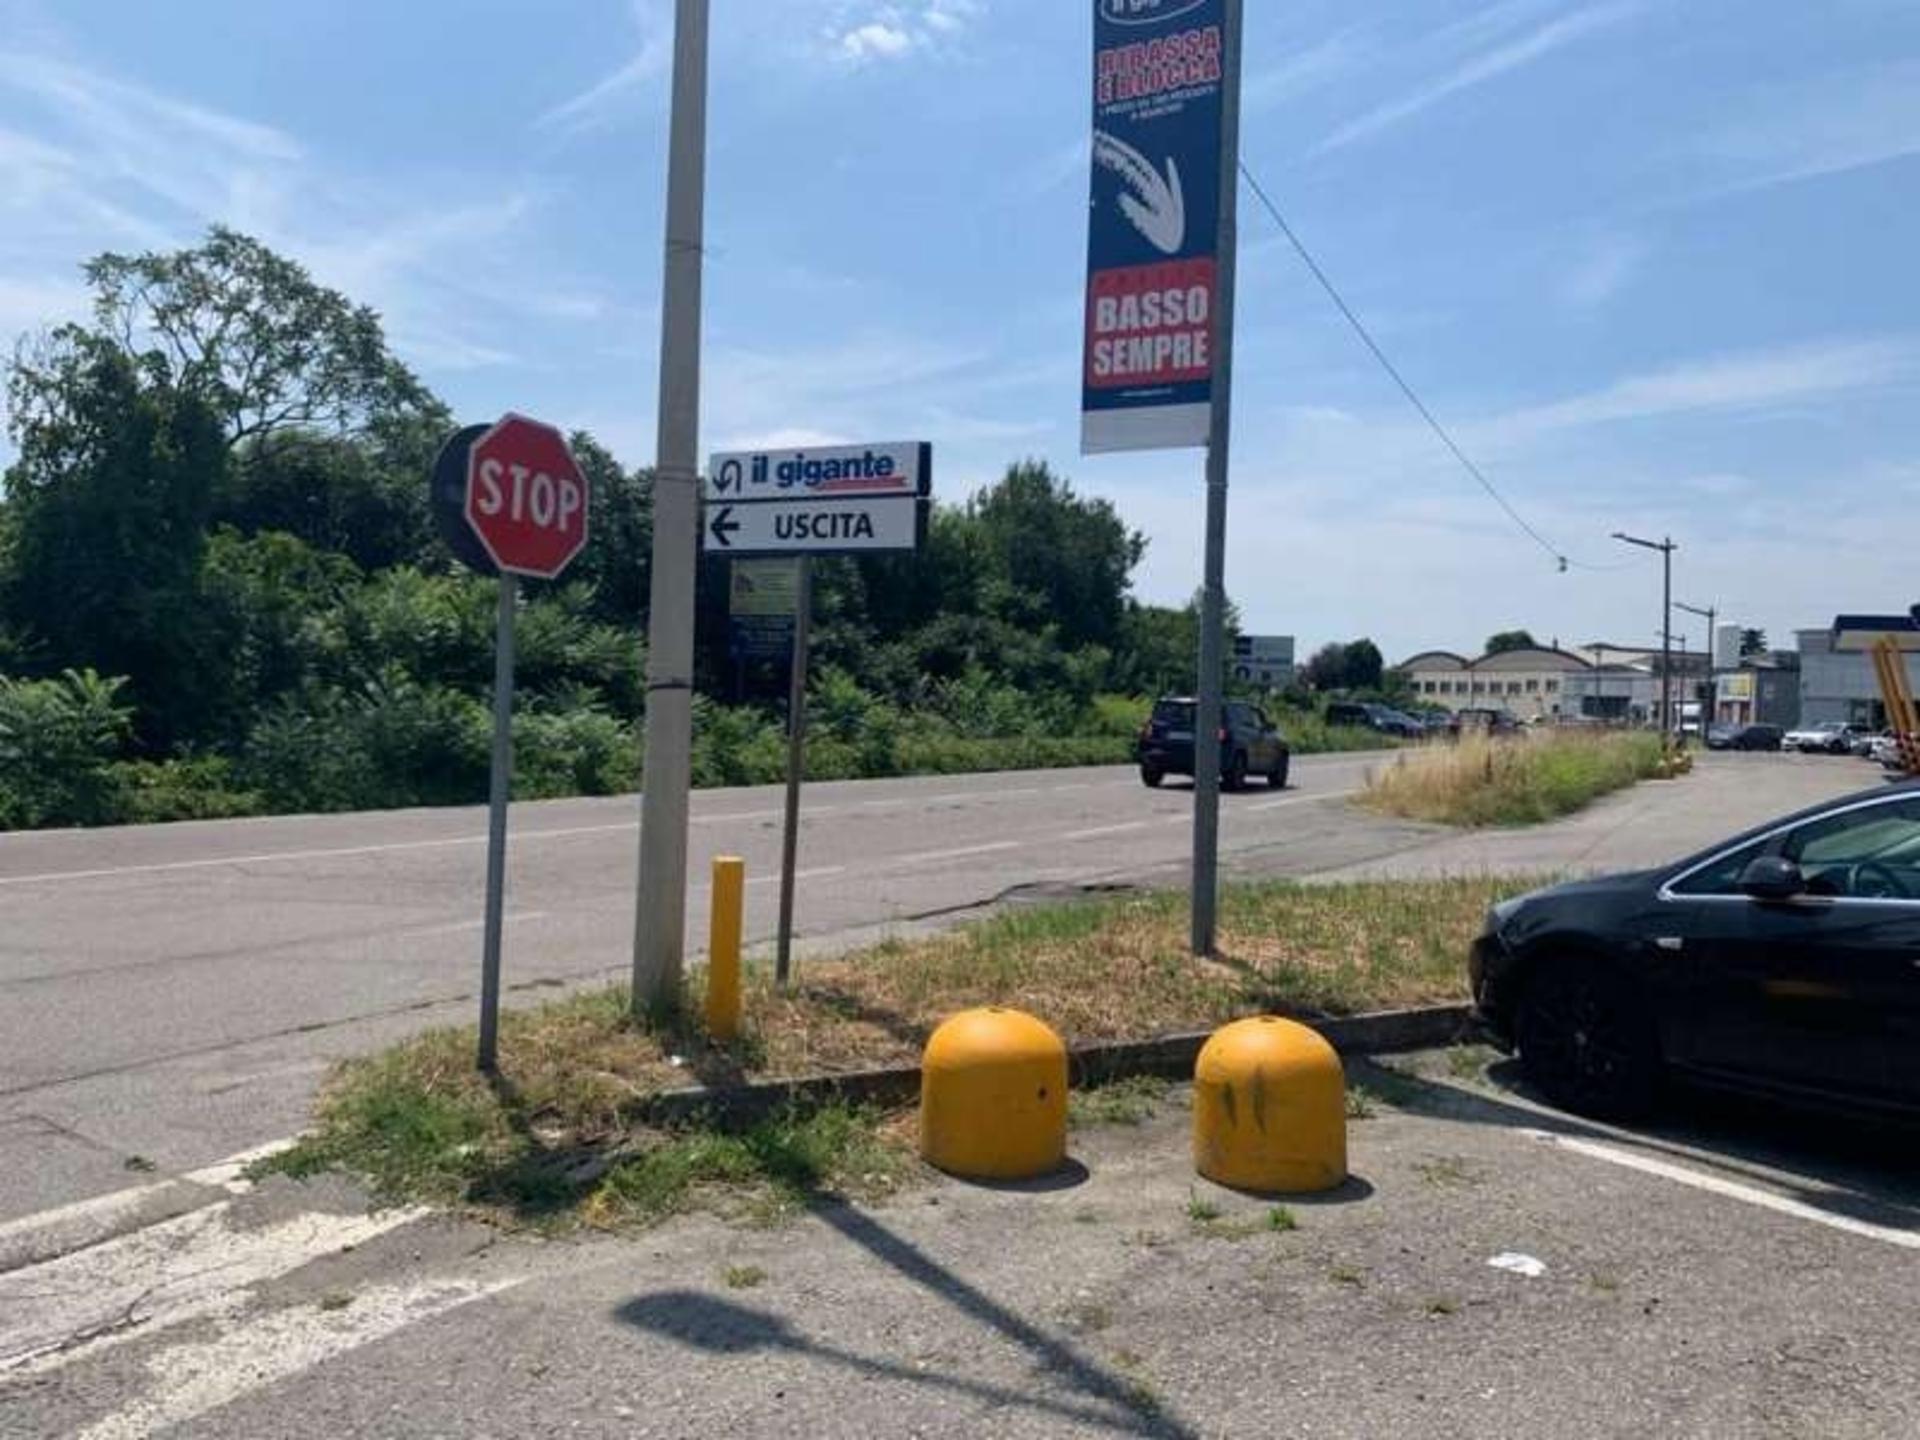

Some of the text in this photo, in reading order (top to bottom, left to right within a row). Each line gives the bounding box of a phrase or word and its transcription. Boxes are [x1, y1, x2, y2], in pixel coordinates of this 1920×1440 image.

[1096, 285, 1208, 333] BASSO
[1093, 331, 1208, 376] SEMPRE
[751, 450, 895, 489] il gigante
[478, 458, 581, 533] STOP
[774, 512, 874, 540] USCITA
